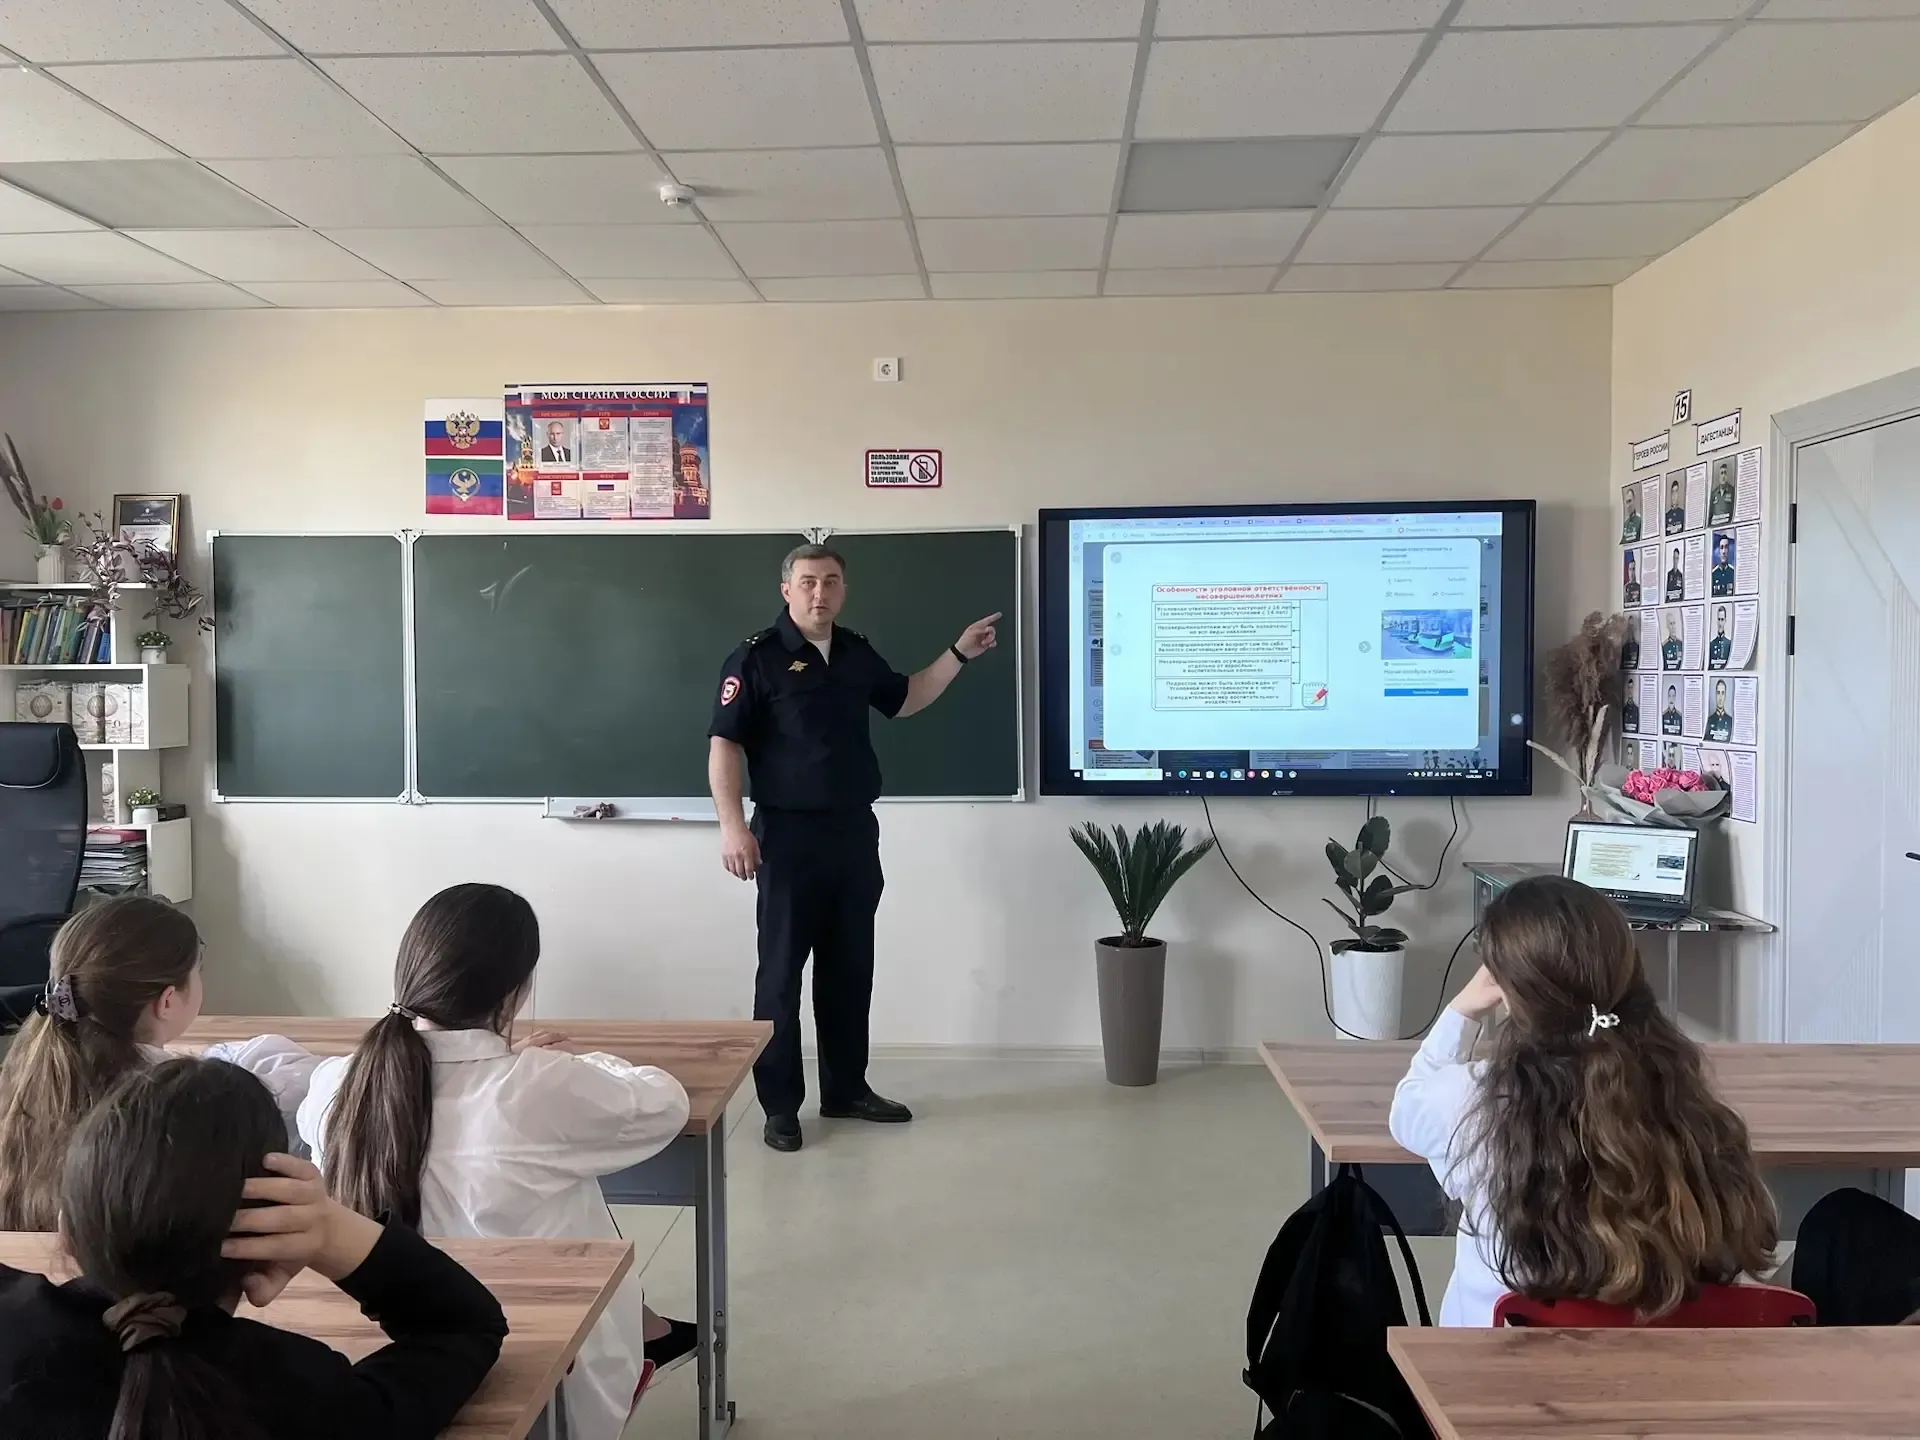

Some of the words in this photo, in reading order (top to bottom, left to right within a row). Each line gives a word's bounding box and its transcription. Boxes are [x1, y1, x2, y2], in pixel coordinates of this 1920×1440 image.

[541, 391, 568, 400] МОЯ
[572, 391, 620, 400] СТРАНА
[624, 391, 671, 399] РОССИЯ
[1675, 395, 1688, 420] 15
[1650, 442, 1668, 456] РОССИИ
[1210, 585, 1251, 593] уголовной
